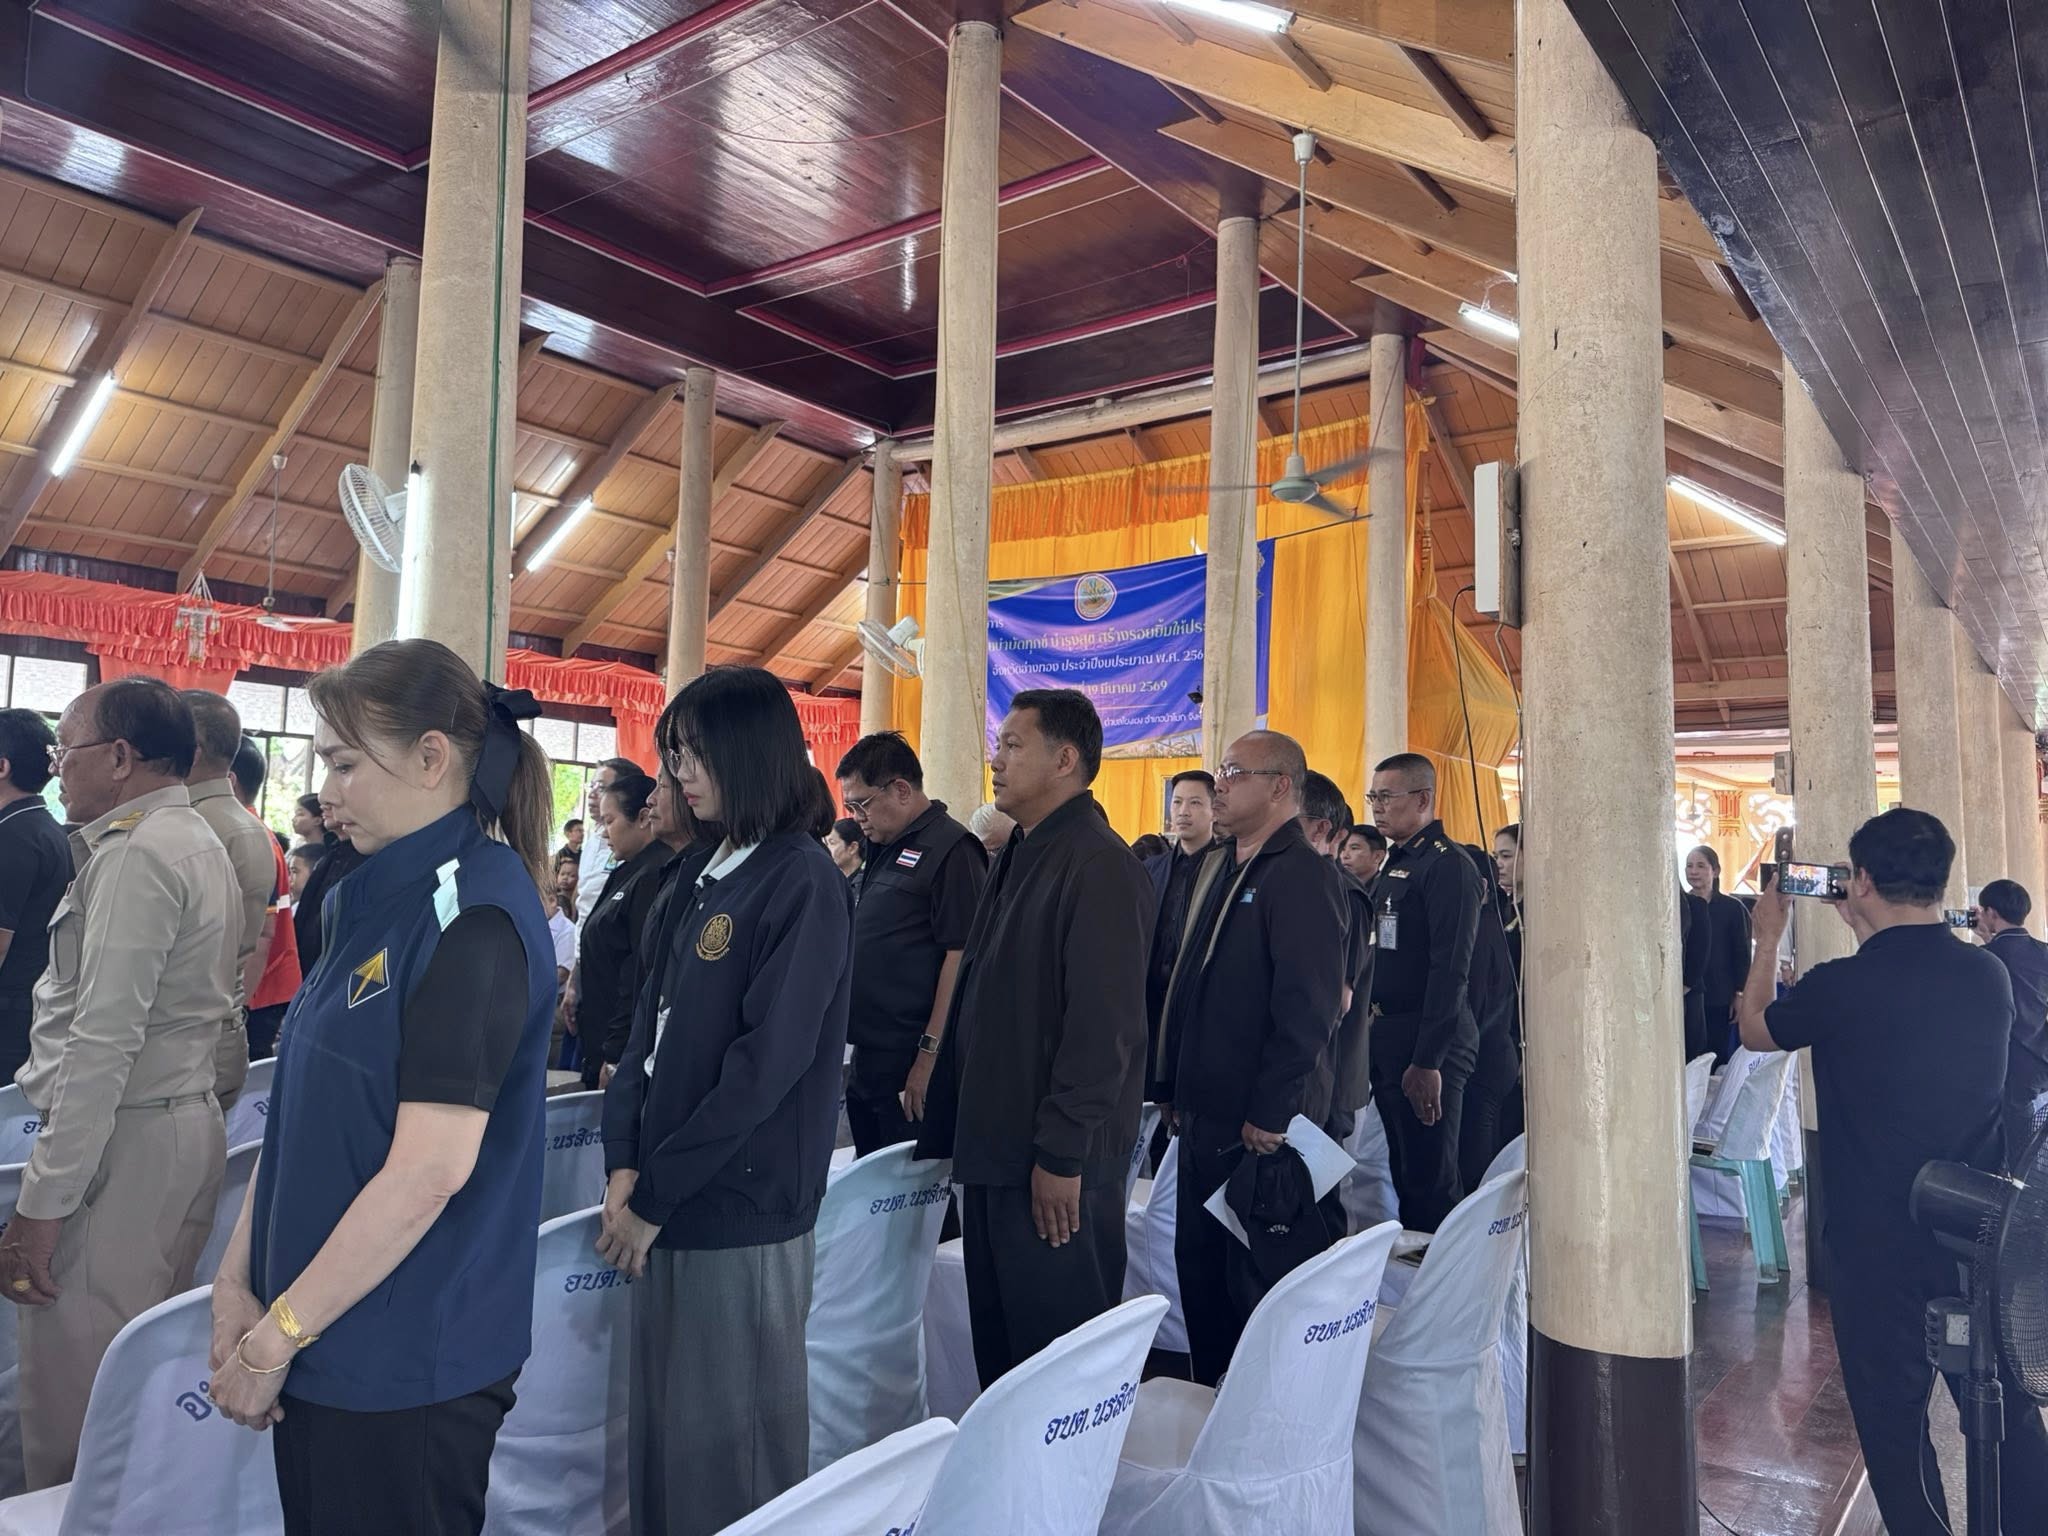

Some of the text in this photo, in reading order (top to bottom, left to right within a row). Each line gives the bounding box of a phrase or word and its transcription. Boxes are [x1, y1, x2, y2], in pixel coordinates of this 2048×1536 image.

[992, 649, 1204, 677] จังหวัดอ่างทอง ประจำปีงบประมาณ พ.ศ. 256
[1100, 681, 1136, 695] มีนาคม
[1139, 680, 1168, 693] 2569
[564, 1269, 633, 1294] อบต.
